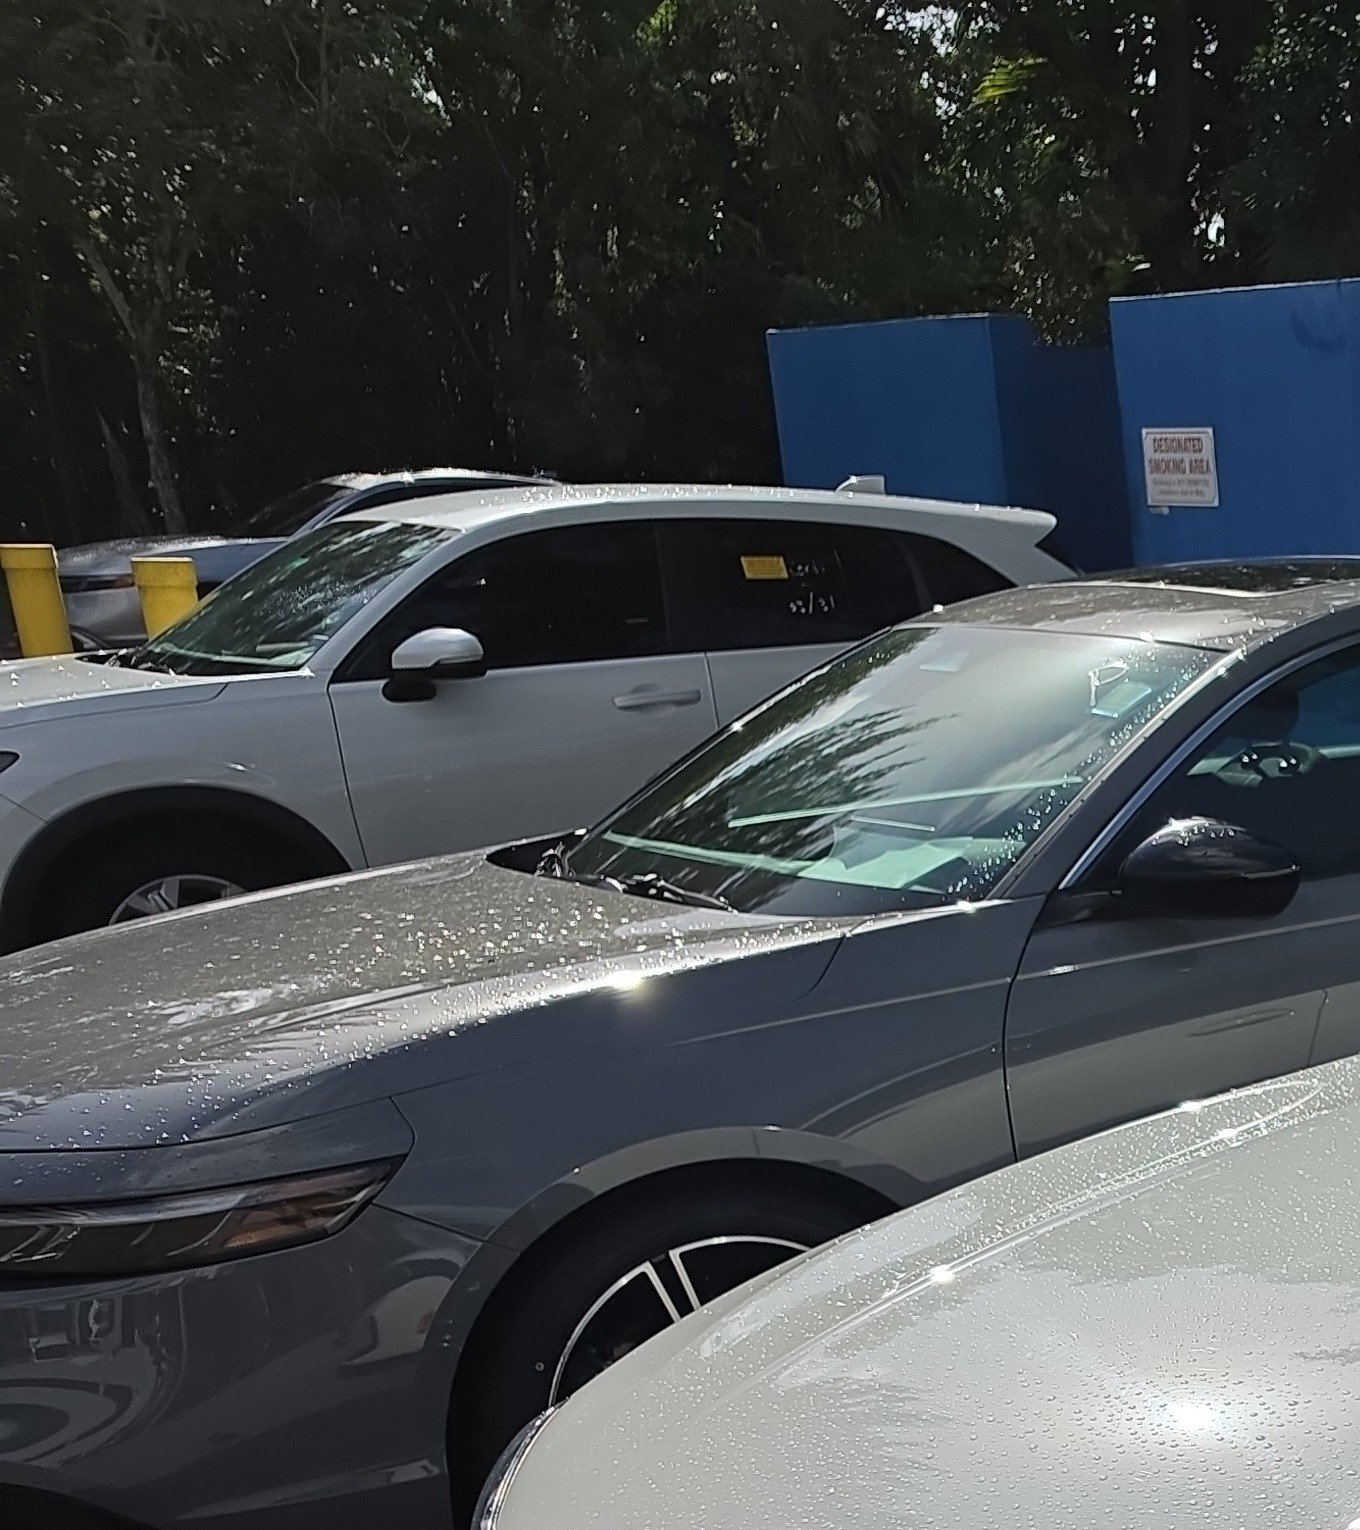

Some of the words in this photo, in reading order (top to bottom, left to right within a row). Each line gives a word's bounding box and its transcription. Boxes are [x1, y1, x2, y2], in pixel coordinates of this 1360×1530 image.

[1152, 437, 1204, 453] DESIGNATED
[1149, 458, 1187, 475] SMOKING
[1189, 458, 1211, 474] AREA
